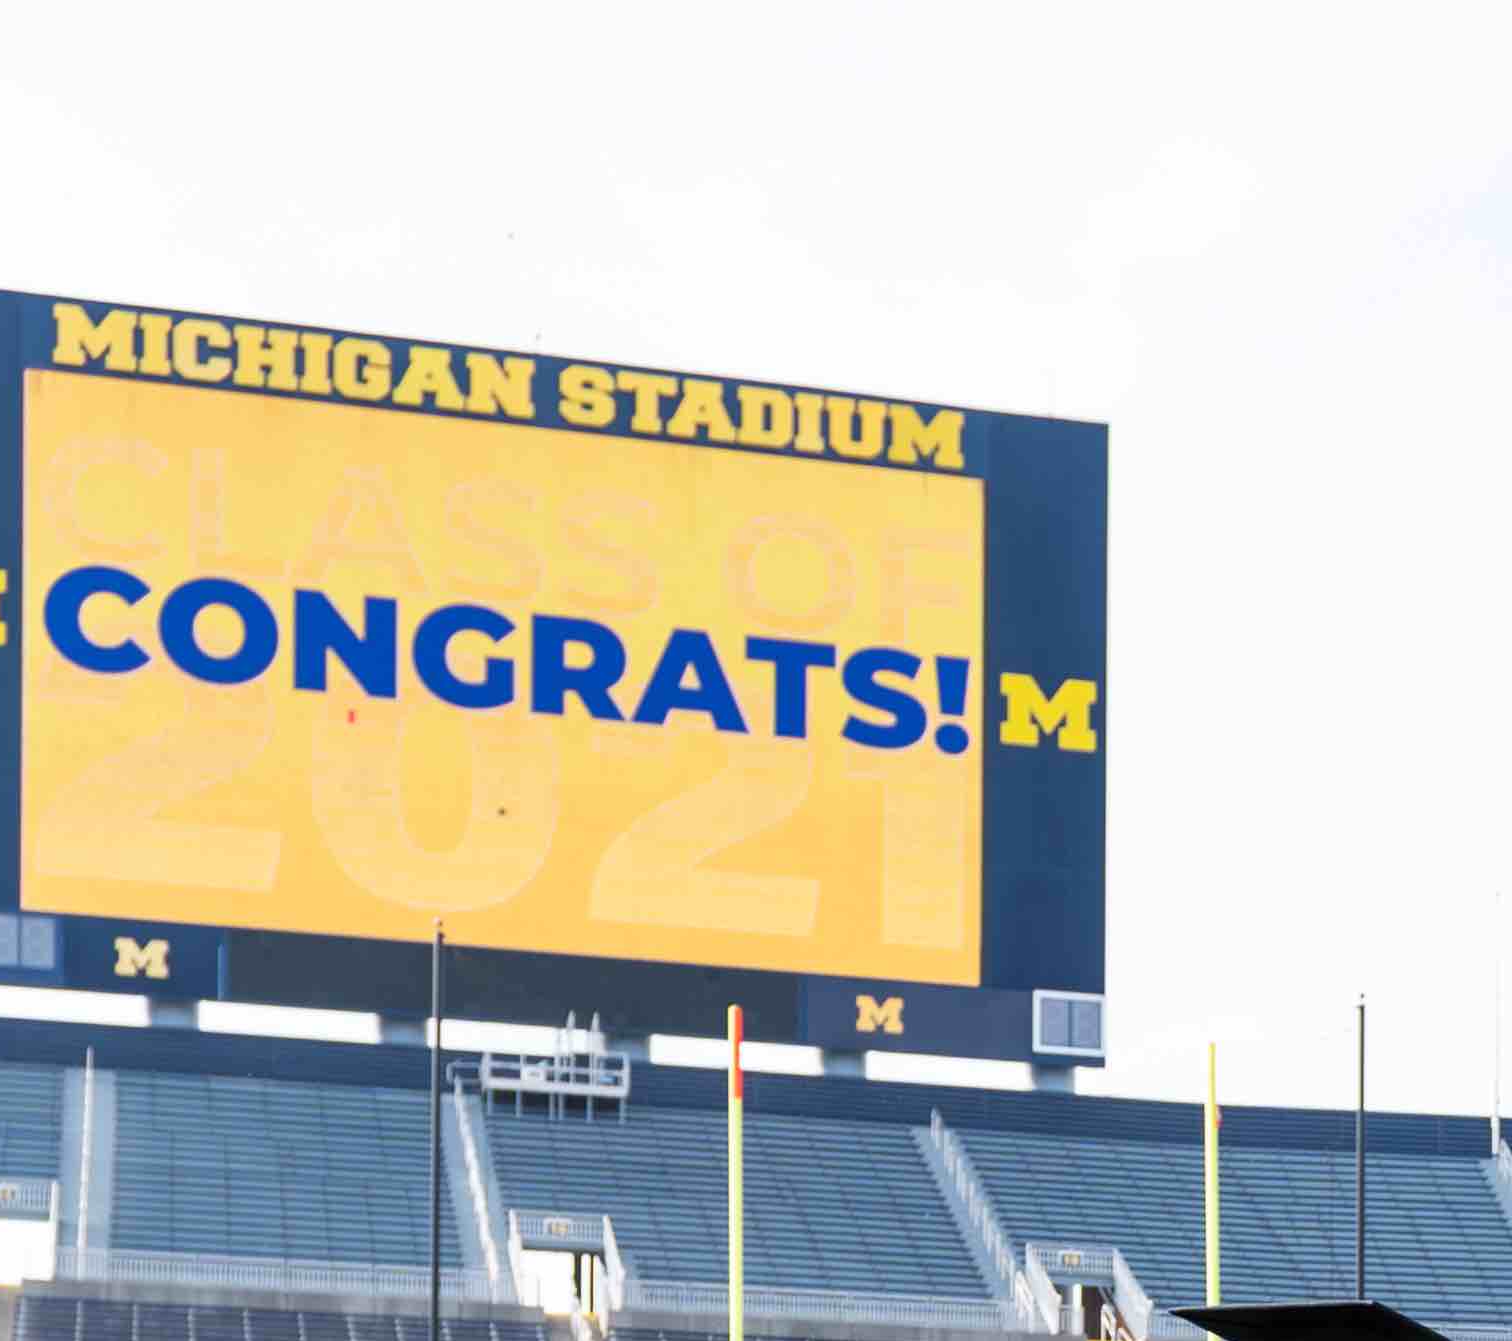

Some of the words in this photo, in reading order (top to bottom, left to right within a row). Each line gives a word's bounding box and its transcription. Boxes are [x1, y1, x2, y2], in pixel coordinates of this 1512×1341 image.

[52, 303, 535, 419] MICHIGAN
[559, 363, 965, 469] STADIUM
[41, 432, 659, 619] CLASS
[724, 510, 971, 641] OF
[44, 565, 971, 755] CONGRATS!
[1000, 672, 1097, 752] M
[114, 937, 170, 980] M
[856, 995, 904, 1035] M
